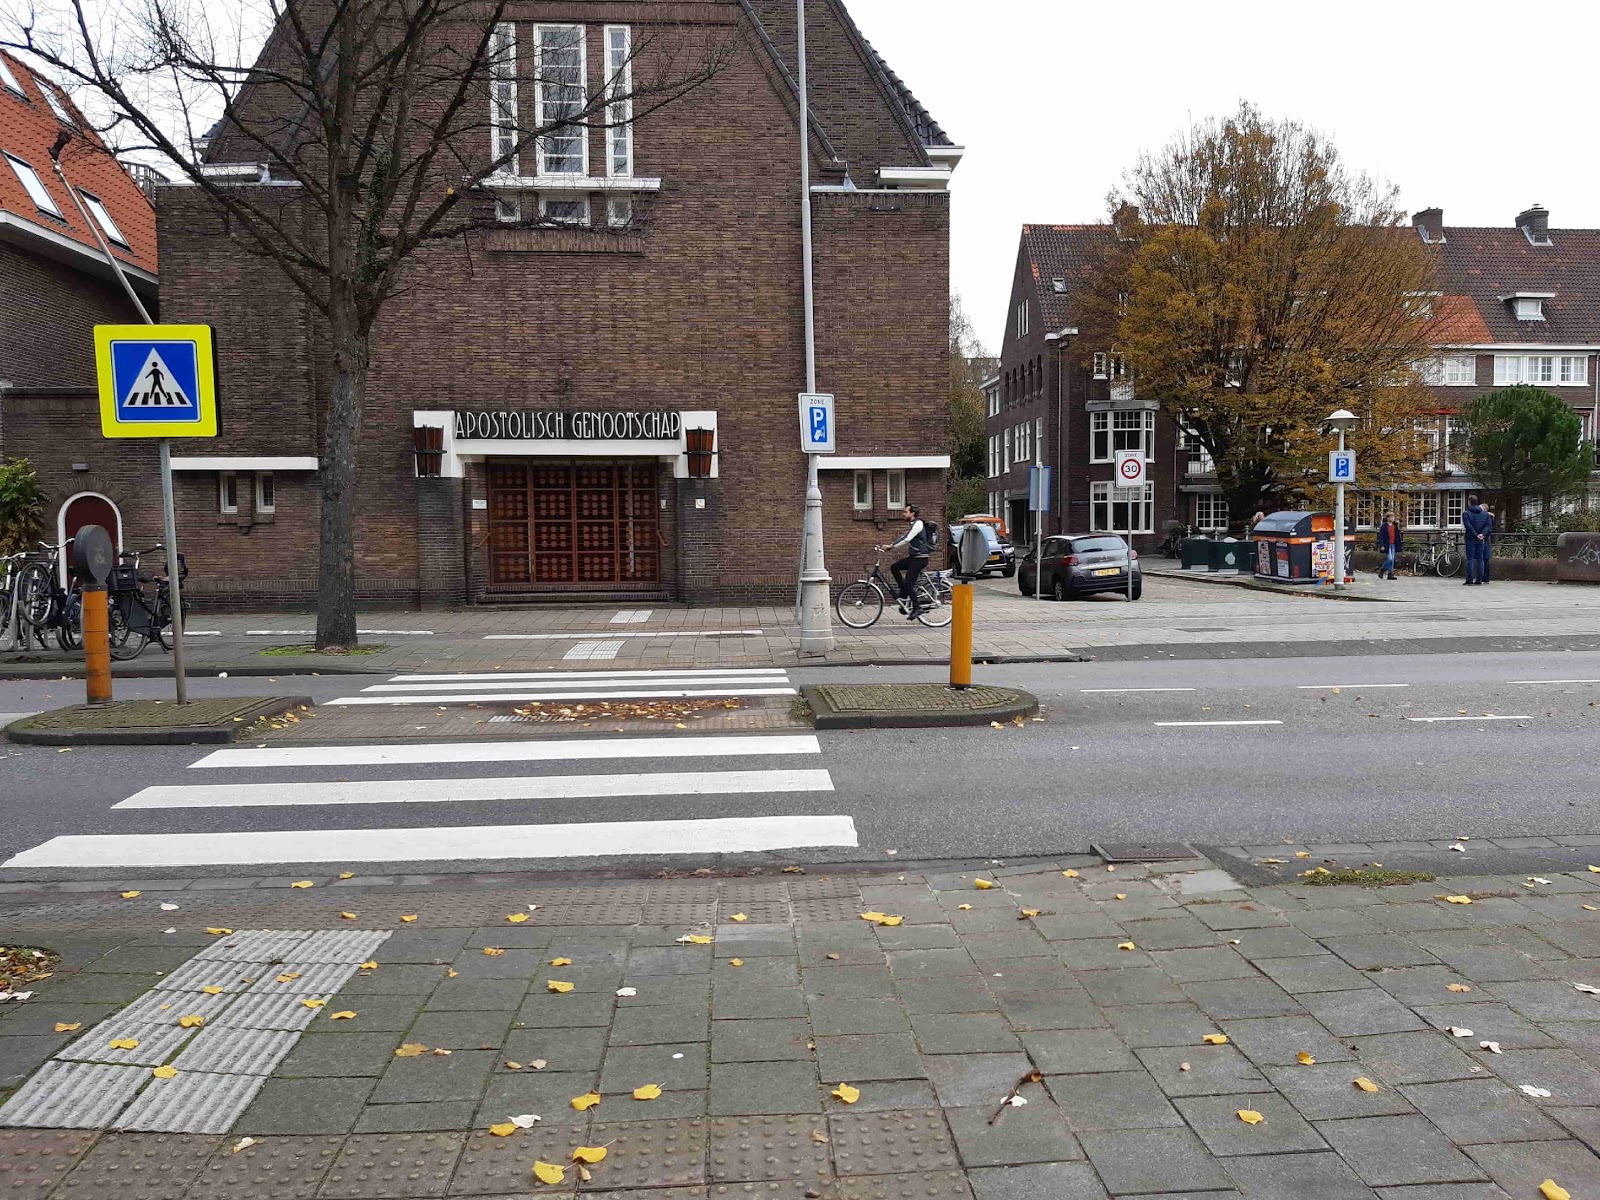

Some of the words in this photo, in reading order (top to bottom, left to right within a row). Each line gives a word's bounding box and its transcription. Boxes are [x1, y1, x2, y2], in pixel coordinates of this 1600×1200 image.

[455, 411, 564, 438] APOSTOLISCH
[573, 411, 680, 438] GENOOTSCHAP
[812, 408, 824, 428] P
[1125, 465, 1138, 473] 30
[1339, 459, 1347, 469] P
